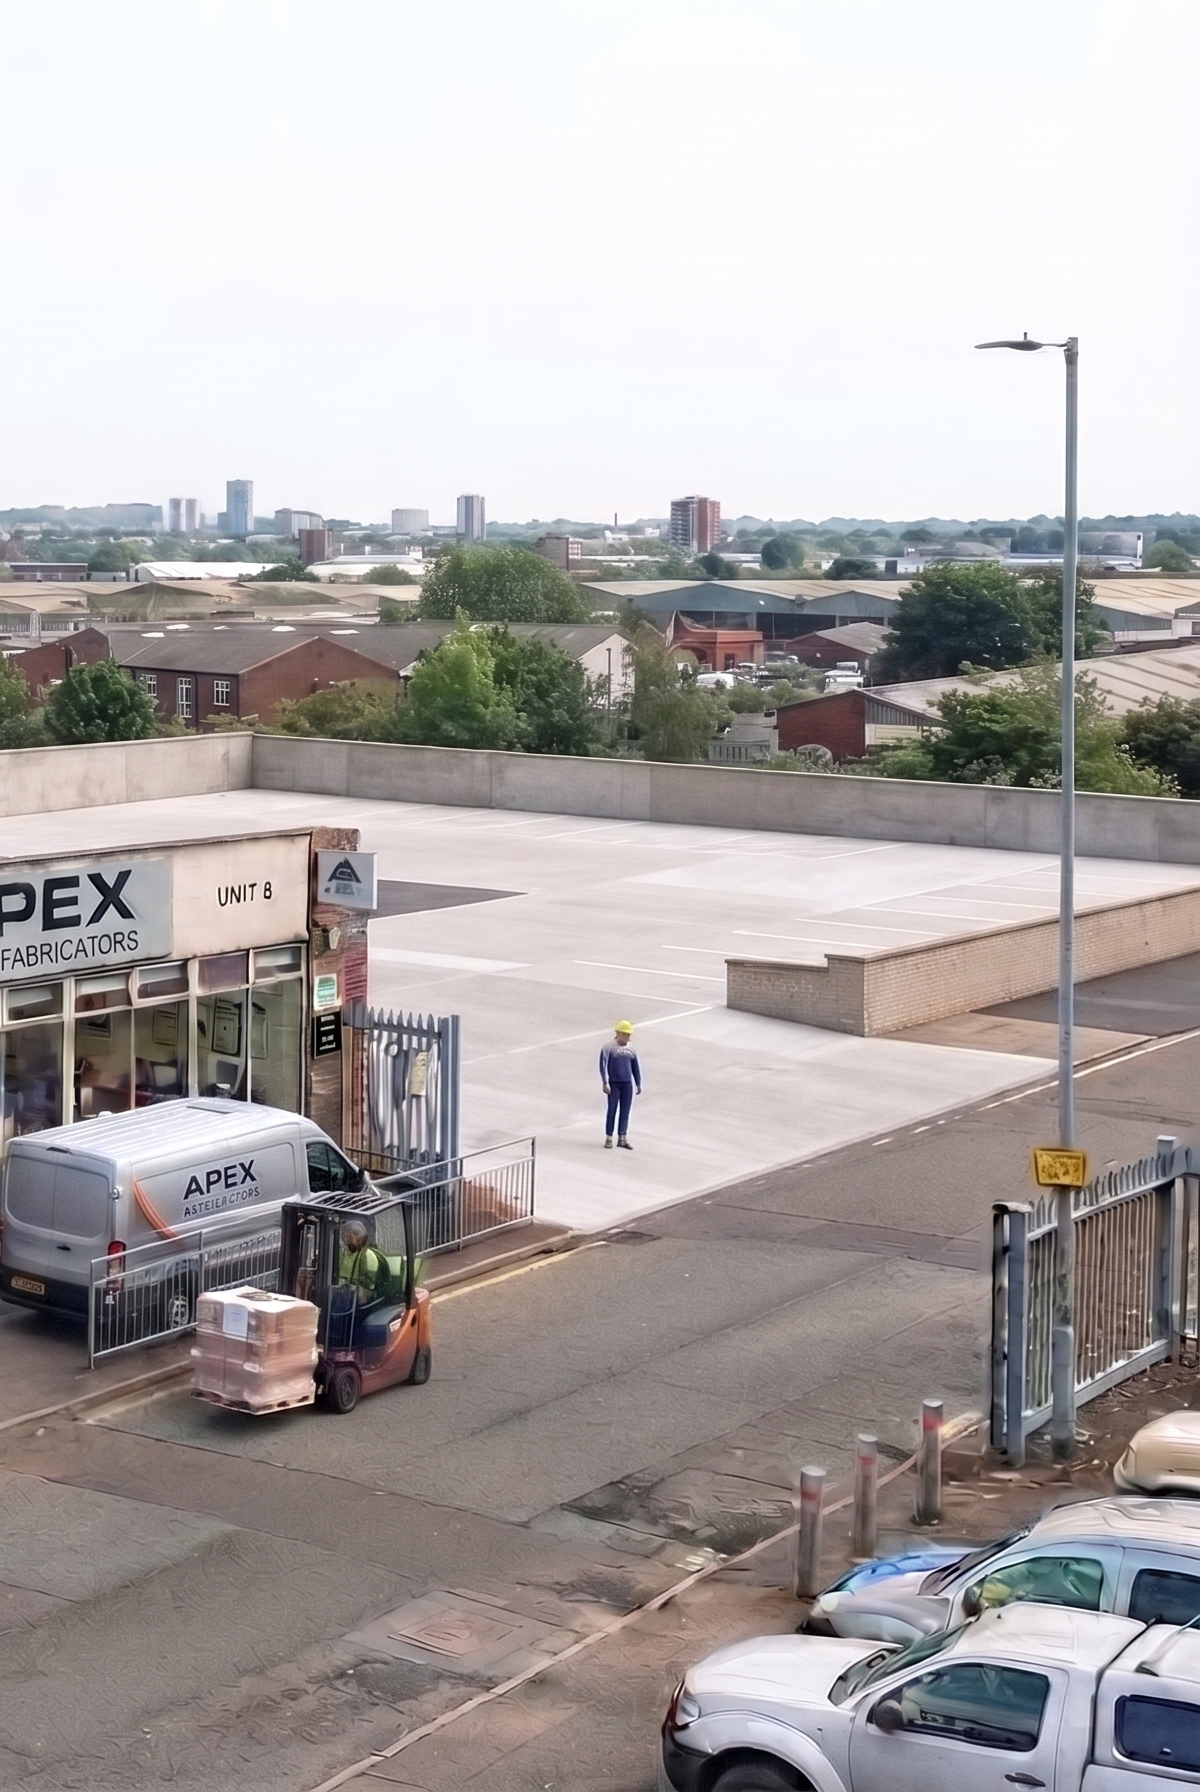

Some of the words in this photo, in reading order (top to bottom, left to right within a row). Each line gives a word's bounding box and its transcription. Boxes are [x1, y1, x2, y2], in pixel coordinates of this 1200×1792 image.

[218, 882, 257, 907] UNIT
[1, 930, 139, 972] FABRICATORS
[183, 1159, 257, 1200] APEX
